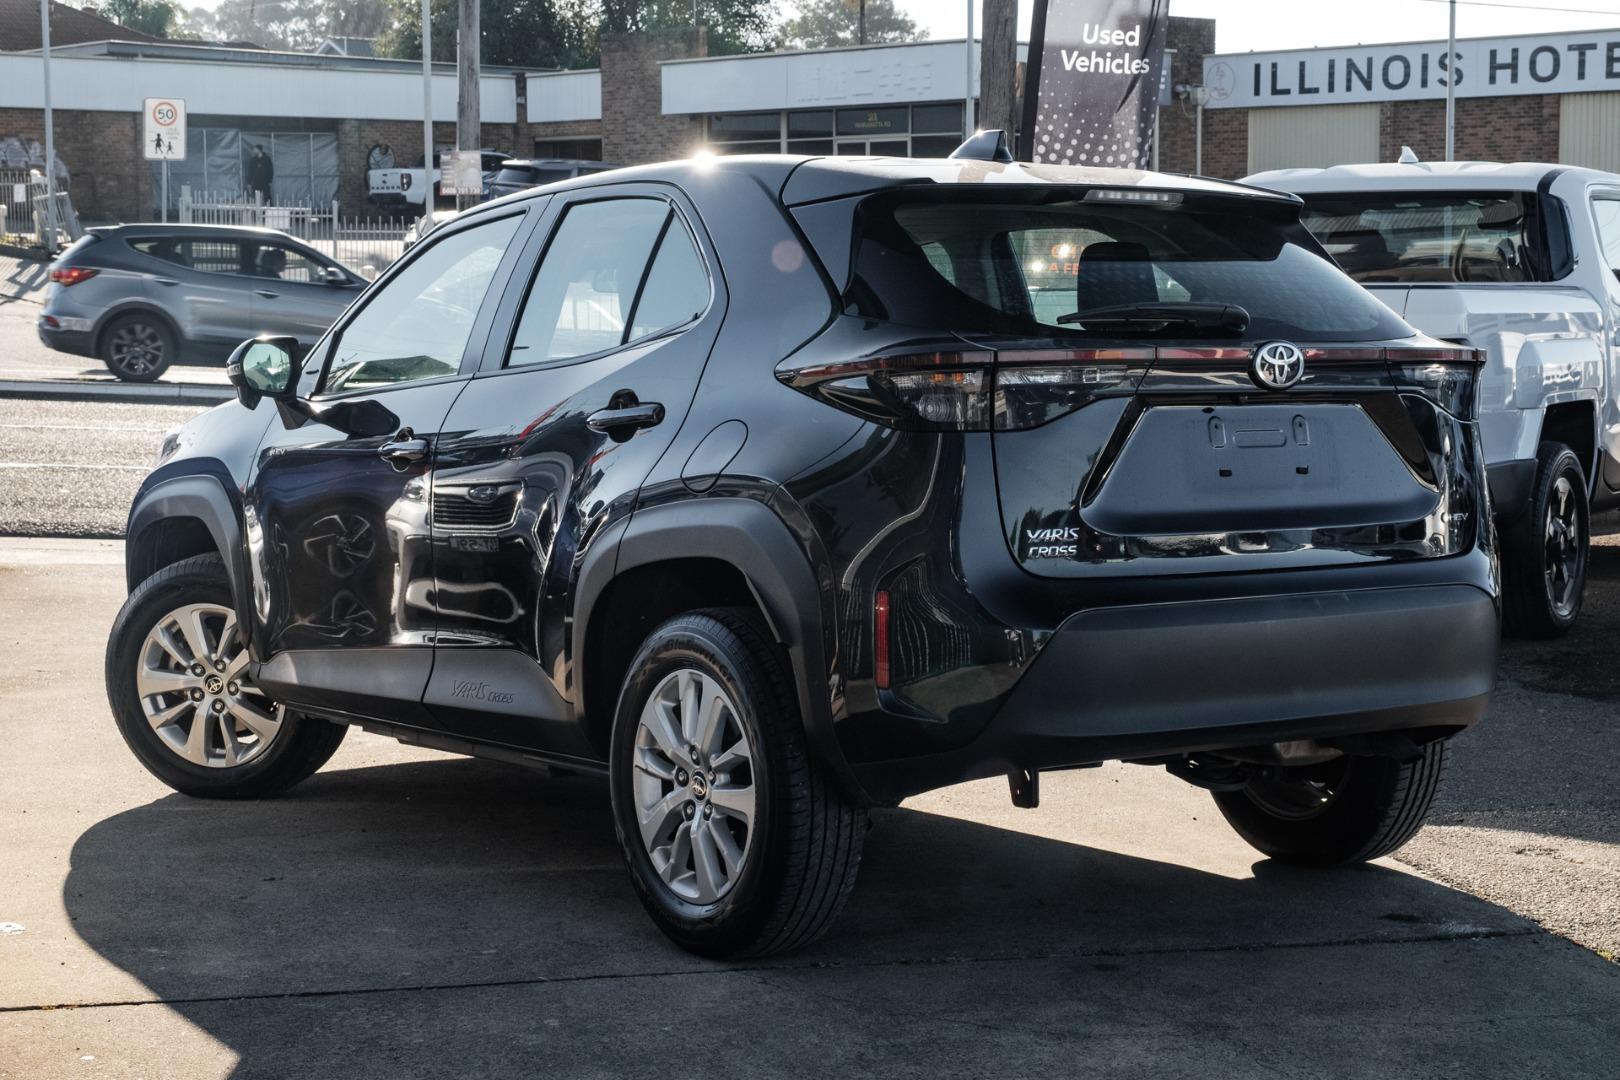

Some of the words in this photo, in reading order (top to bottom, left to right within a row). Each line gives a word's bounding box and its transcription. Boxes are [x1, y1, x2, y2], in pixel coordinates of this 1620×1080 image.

[1082, 23, 1140, 46] Used
[1060, 49, 1150, 74] Vehicles
[1253, 51, 1464, 97] ILLINOIS
[158, 109, 174, 119] 50
[1027, 527, 1080, 541] YARIS
[450, 680, 491, 699] YARIS
